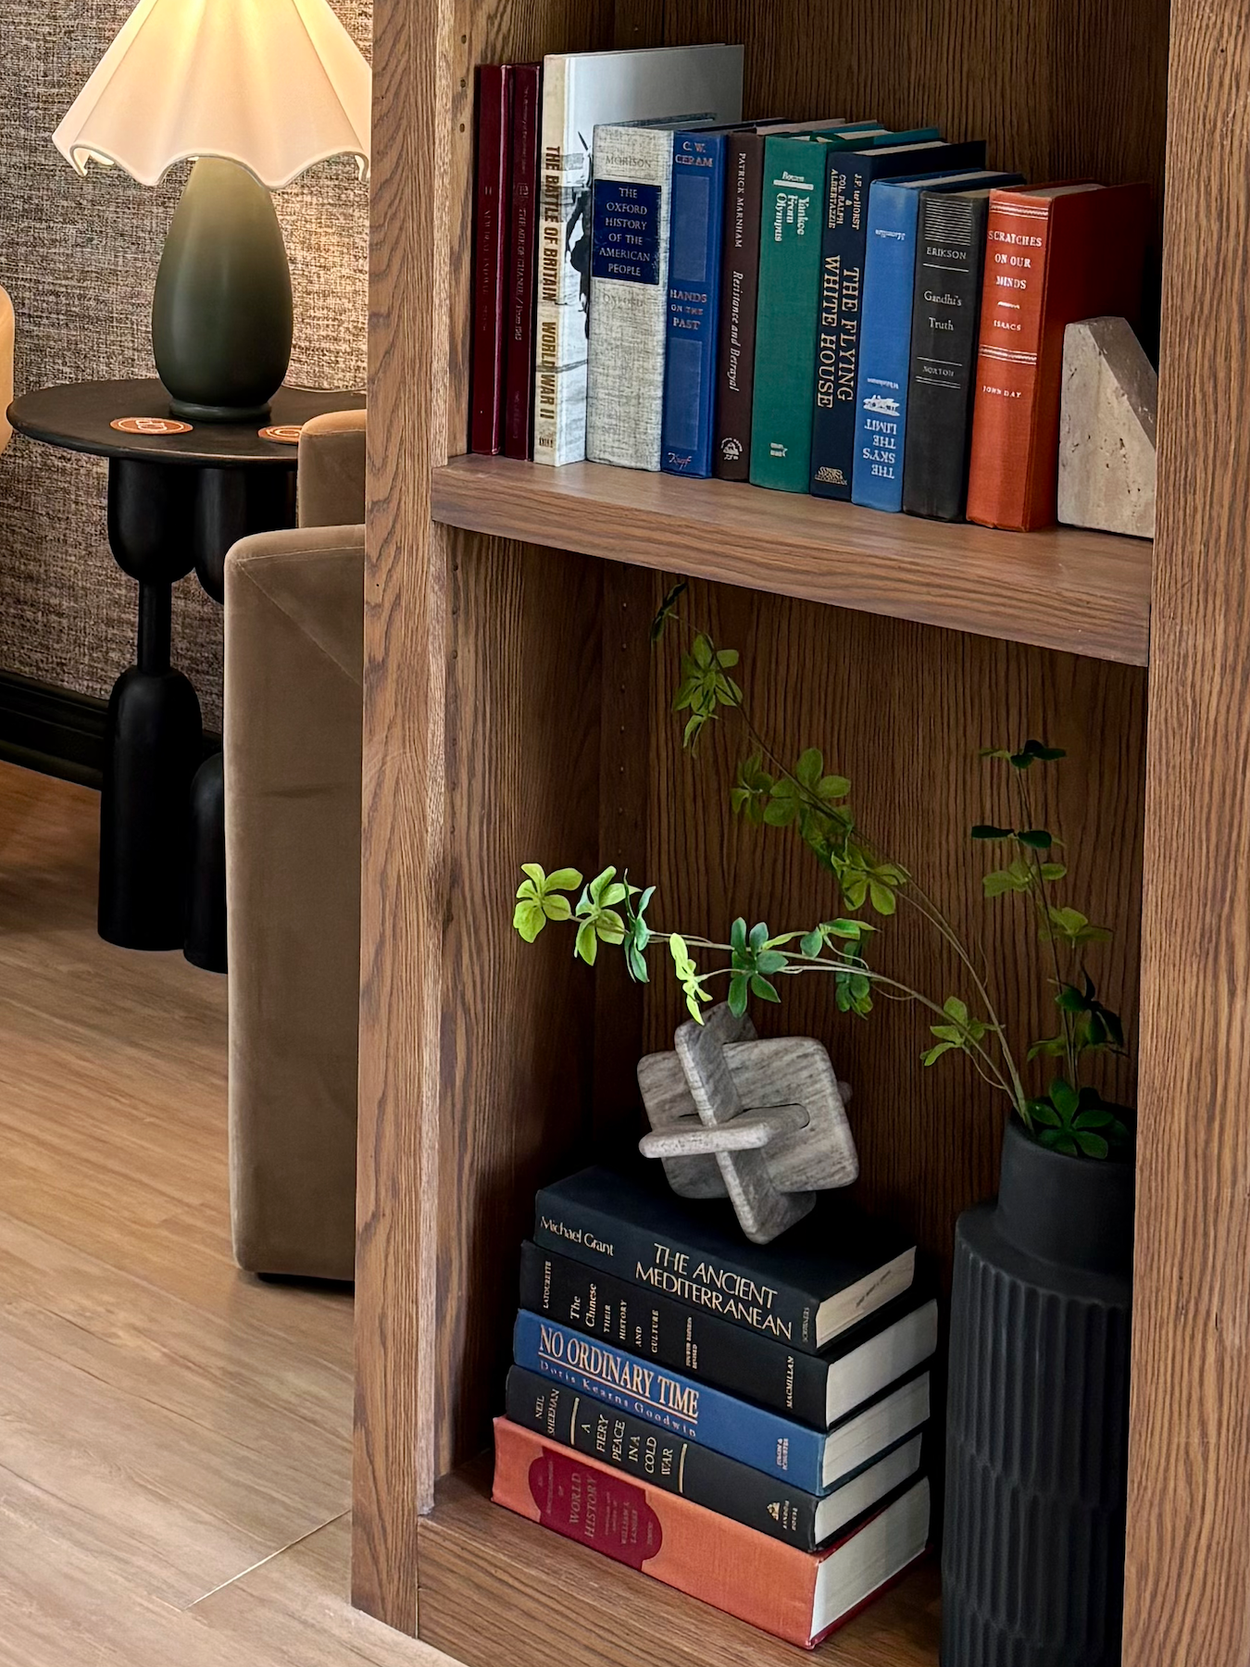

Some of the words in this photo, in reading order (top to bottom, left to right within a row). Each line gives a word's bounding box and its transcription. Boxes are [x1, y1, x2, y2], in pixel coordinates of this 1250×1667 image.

[545, 146, 560, 170] THE
[682, 141, 693, 152] C.
[694, 142, 706, 153] W.
[605, 155, 650, 168] MORISON
[675, 154, 713, 168] CERAM
[736, 152, 747, 194] PATRICK
[544, 175, 560, 222] BATTLE
[619, 187, 637, 199] THE
[828, 169, 838, 229] ALBERTAZZIE
[606, 202, 647, 215] OXFORD
[773, 192, 787, 242] Olympus
[786, 195, 798, 223] From
[797, 196, 810, 236] Yankee
[836, 195, 845, 224] RALPH
[543, 226, 559, 245] OF
[605, 217, 647, 230] HISTORY
[734, 197, 745, 248] MARNHAM
[608, 233, 622, 243] OF
[625, 234, 643, 246] THE
[988, 230, 1042, 248] SCRATCHES
[599, 247, 650, 261] AMERICAN
[926, 246, 967, 260] ERIKSON
[995, 253, 1008, 265] ON
[1010, 256, 1031, 269] OUR
[542, 248, 558, 302] BRITAIN
[608, 263, 641, 276] PEOPLE
[996, 275, 1027, 290] MINDS
[670, 289, 707, 303] HANDS
[731, 271, 743, 323] Resistance
[822, 255, 841, 327] WHITE
[842, 267, 860, 311] THE
[924, 291, 962, 308] Gandhi's
[671, 304, 682, 313] ON
[685, 307, 703, 315] THE
[673, 317, 702, 330] PAST
[730, 324, 741, 347] and
[928, 316, 954, 332] Truth
[993, 320, 1021, 332] ISAACS
[541, 321, 556, 369] WORLD
[728, 348, 740, 392] Betrayal
[817, 333, 836, 409] HOUSE
[836, 319, 857, 401] FLYING
[923, 365, 955, 377] NORTON
[540, 373, 556, 403] WAR
[983, 385, 1002, 395] JOHN
[1004, 390, 1021, 399] DAY
[540, 407, 554, 419] II
[864, 418, 897, 435] LIMIT
[872, 434, 896, 449] THE
[862, 447, 896, 464] SKY'S
[871, 464, 895, 479] THE
[541, 1215, 582, 1244] Michael
[584, 1233, 614, 1256] Grant
[542, 1261, 552, 1309] LATOURETTE
[654, 1242, 690, 1275] THE
[693, 1262, 778, 1309] ANCIENT
[570, 1295, 581, 1320] The
[585, 1283, 597, 1327] Chinese
[635, 1261, 792, 1341] MEDITERRANEAN
[603, 1304, 611, 1333] THEIR
[619, 1299, 628, 1340] HISTORY
[651, 1309, 659, 1354] CULTURE
[539, 1324, 564, 1358] NO
[567, 1338, 654, 1398] ORDINARY
[657, 1375, 699, 1419] TIME
[786, 1356, 794, 1409] MACMILLAN
[535, 1395, 545, 1420] NEIL
[540, 1360, 576, 1384] Doris
[582, 1378, 629, 1408] Kearns
[634, 1402, 697, 1438] Goodwin
[547, 1389, 560, 1436] SHEEHAN
[581, 1424, 591, 1433] A
[596, 1414, 609, 1452] FIERY
[611, 1420, 626, 1462] PEACE
[630, 1435, 641, 1446] A
[628, 1447, 639, 1462] IN
[644, 1437, 658, 1474] COLD
[661, 1448, 674, 1475] WAR
[570, 1472, 582, 1523] WORLD
[584, 1473, 598, 1538] HISTORY
